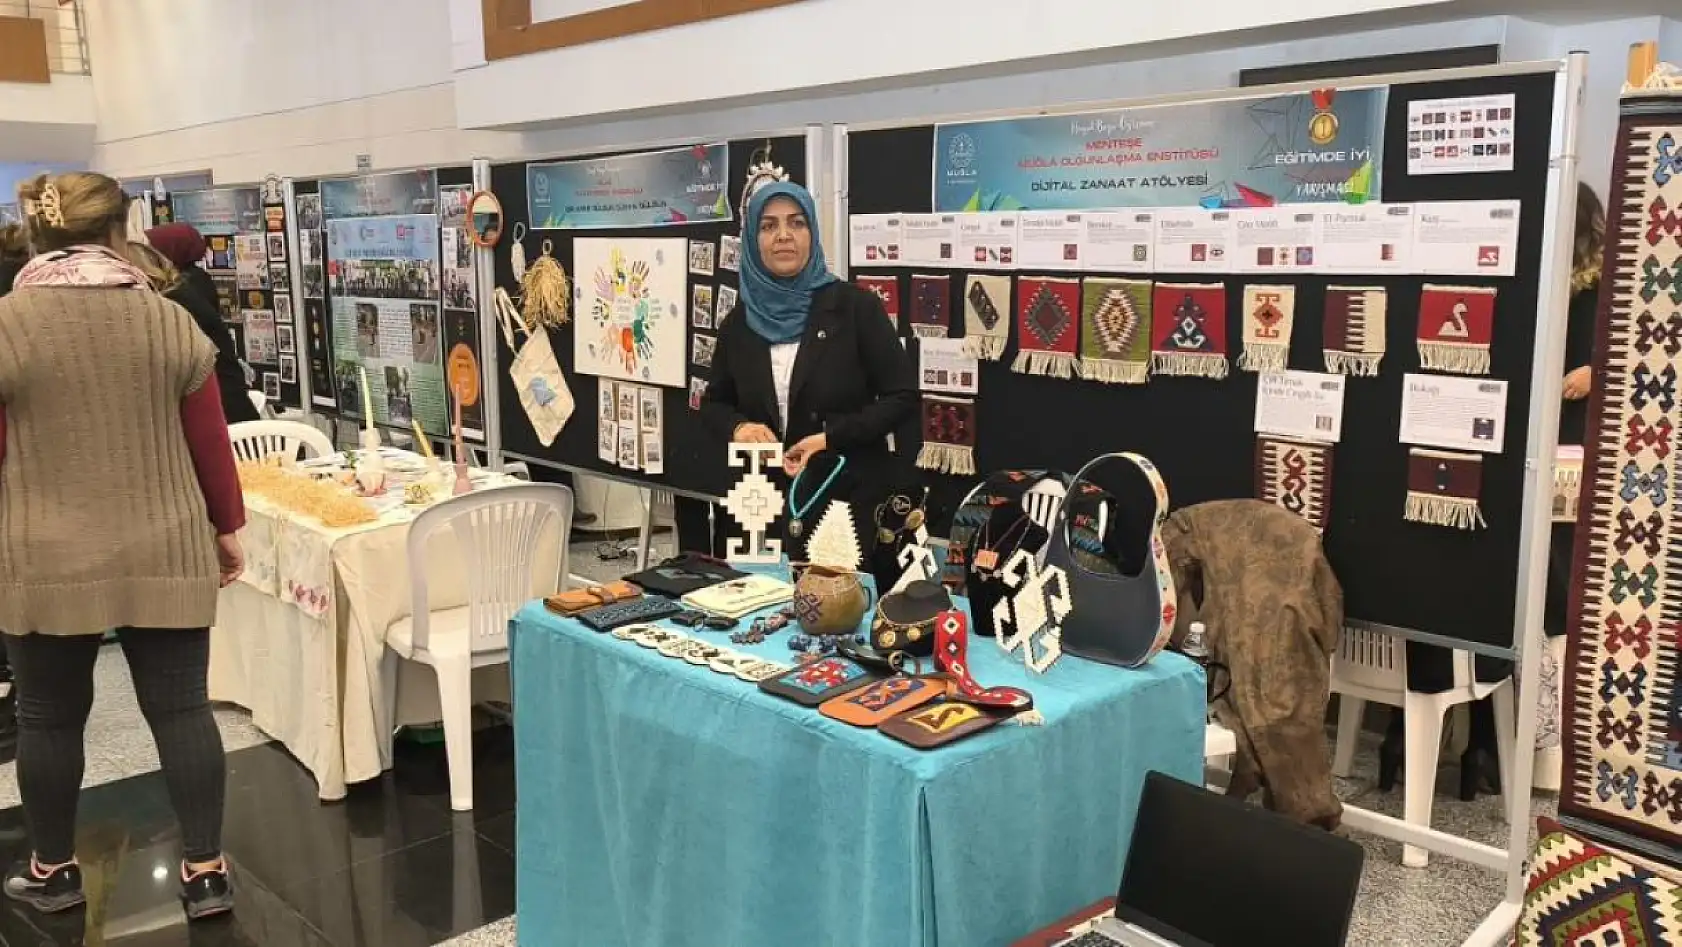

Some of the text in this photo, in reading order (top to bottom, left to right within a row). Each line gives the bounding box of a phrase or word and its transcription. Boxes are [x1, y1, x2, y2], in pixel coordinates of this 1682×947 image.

[1085, 136, 1143, 151] MENTEŞE
[1060, 151, 1143, 167] OLGUNLAŞMA
[1146, 145, 1220, 162] ENSTİTÜSÜ
[1275, 146, 1371, 164] EĞİTİMDE İYİ
[1031, 170, 1209, 192] DİJİTAL ZANAAT ATÖLYESİ
